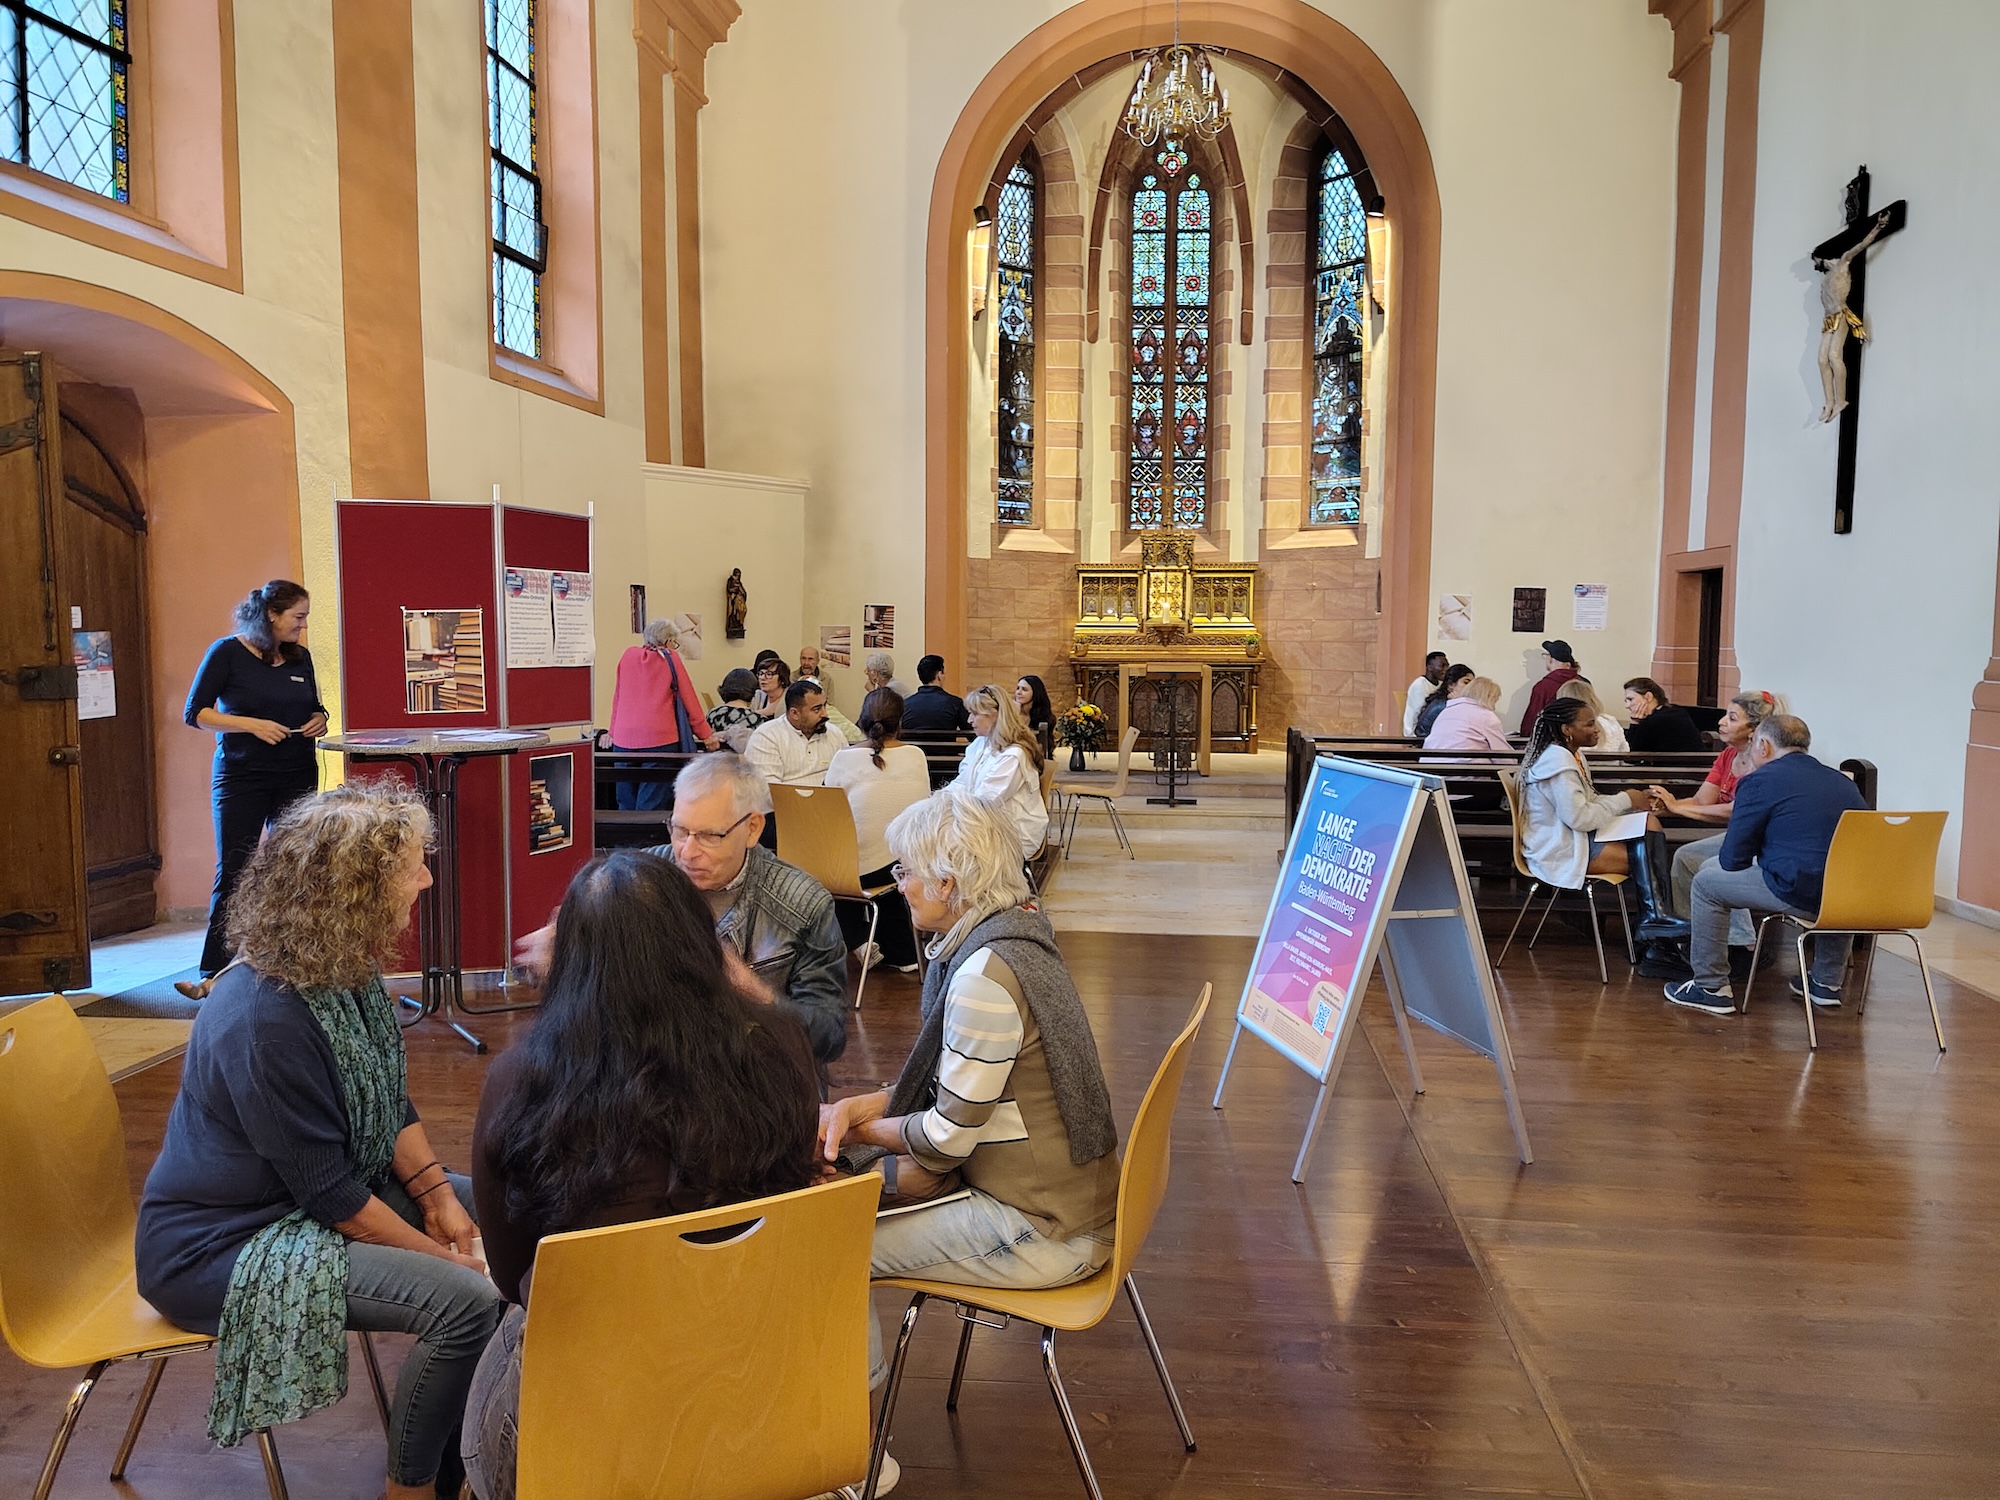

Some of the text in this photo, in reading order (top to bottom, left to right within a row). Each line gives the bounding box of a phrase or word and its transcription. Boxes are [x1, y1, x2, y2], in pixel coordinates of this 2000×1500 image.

[1316, 810, 1358, 842] LANGE
[1312, 833, 1376, 877] NACHT DER
[1300, 853, 1373, 902] DEMOKRATIE
[1297, 880, 1357, 922] Baden-Württemberg
